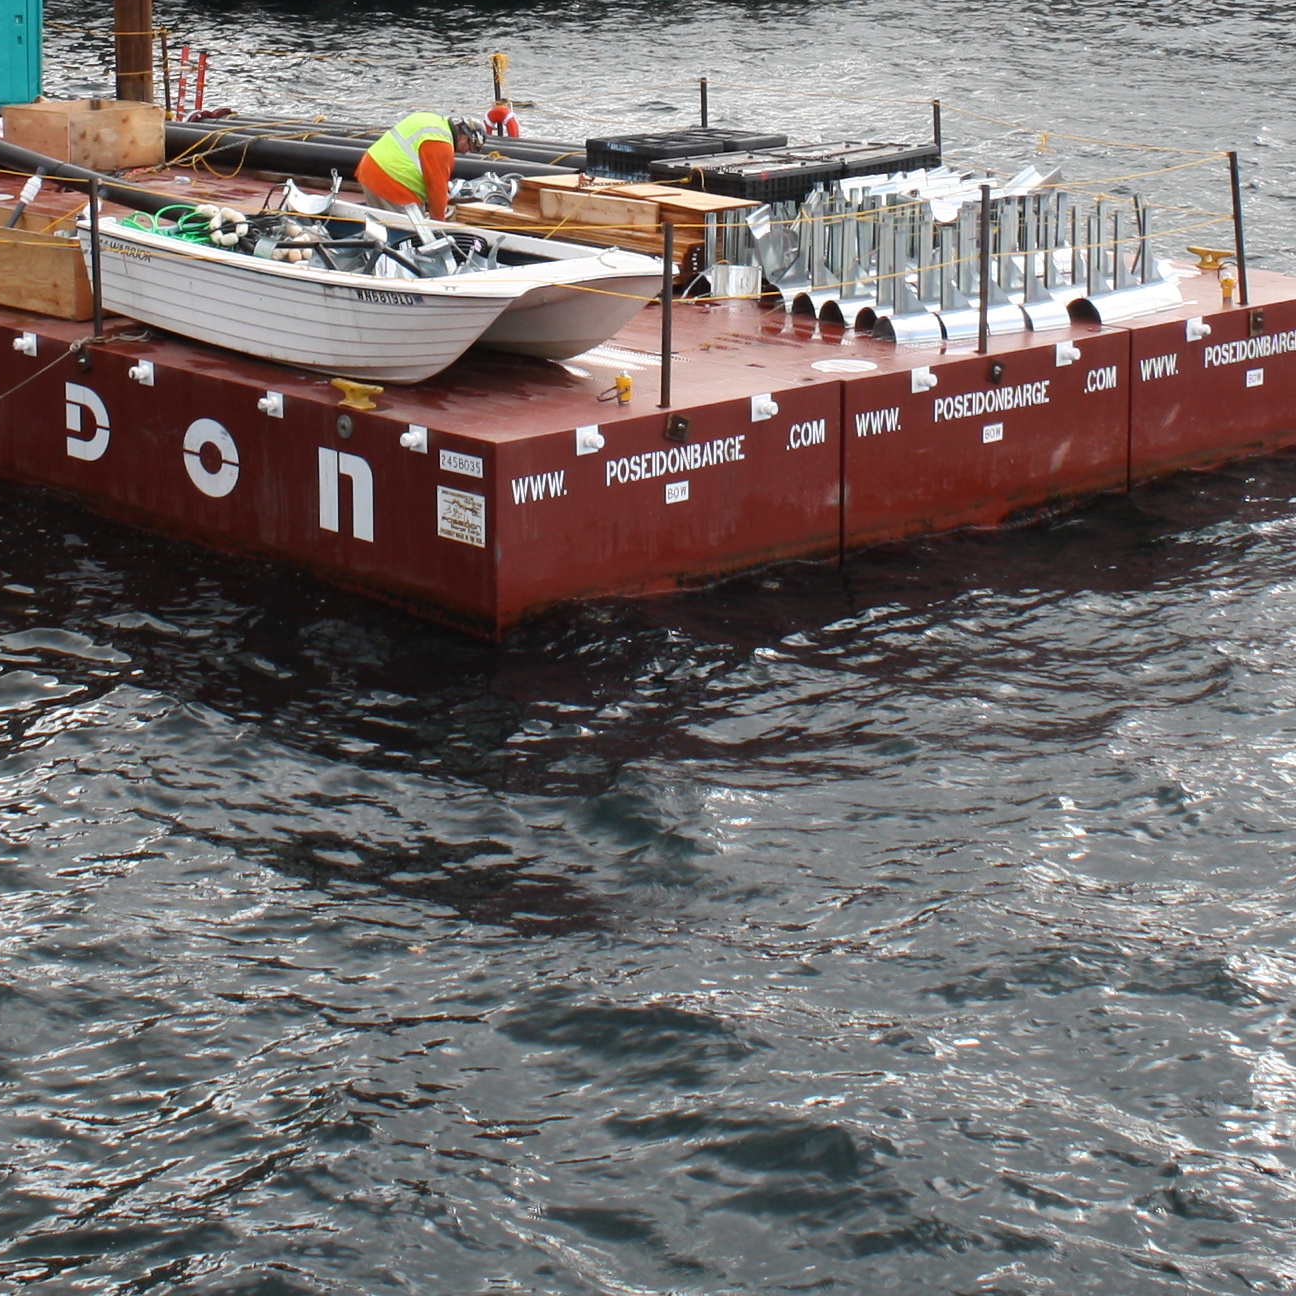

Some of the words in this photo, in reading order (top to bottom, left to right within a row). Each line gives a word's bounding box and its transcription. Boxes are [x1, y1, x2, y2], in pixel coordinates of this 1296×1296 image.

[1140, 354, 1179, 381] WWW.
[855, 407, 901, 437] WWW.
[934, 380, 1050, 422] POSEIDONBARGE
[1083, 365, 1117, 393] .COM
[984, 426, 1002, 440] BOW
[511, 470, 567, 505] WWW.
[606, 435, 746, 486] POSEIDONBARGE
[786, 419, 826, 451] .COM
[667, 486, 688, 500] BOW
